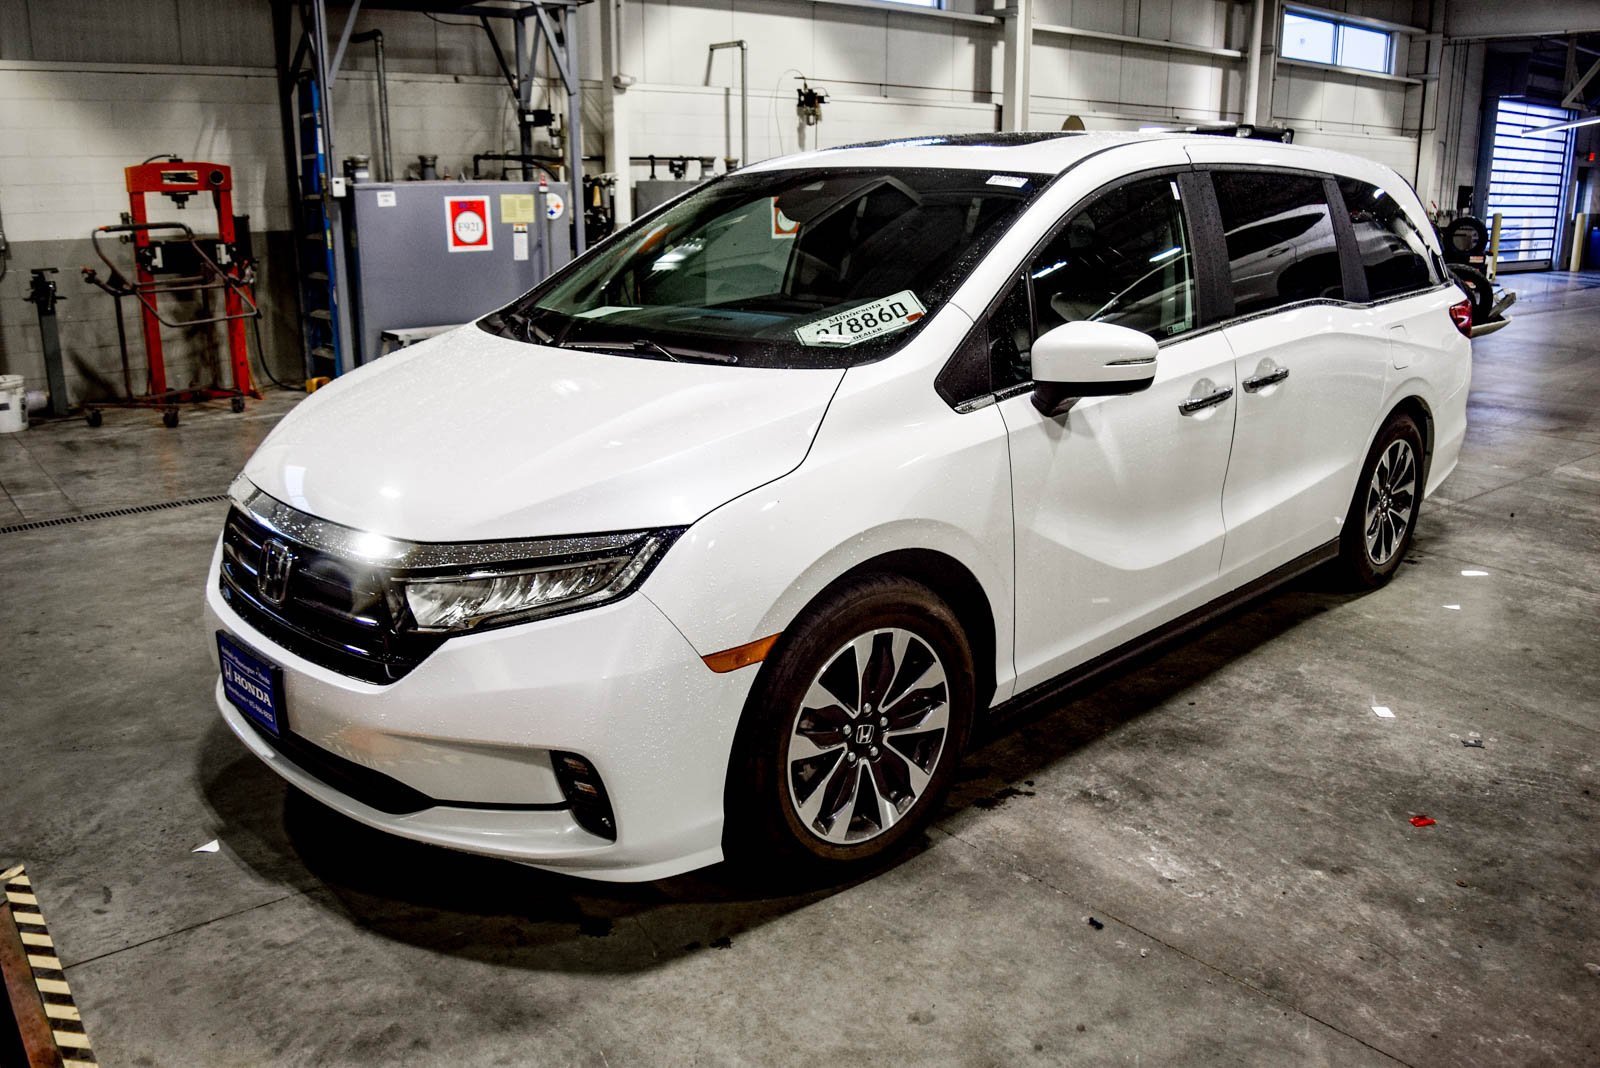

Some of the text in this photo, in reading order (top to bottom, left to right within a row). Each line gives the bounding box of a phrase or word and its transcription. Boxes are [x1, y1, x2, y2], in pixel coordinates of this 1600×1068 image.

[828, 303, 881, 324] Minnesota
[852, 327, 883, 340] DEALER
[233, 671, 272, 708] HONDA
